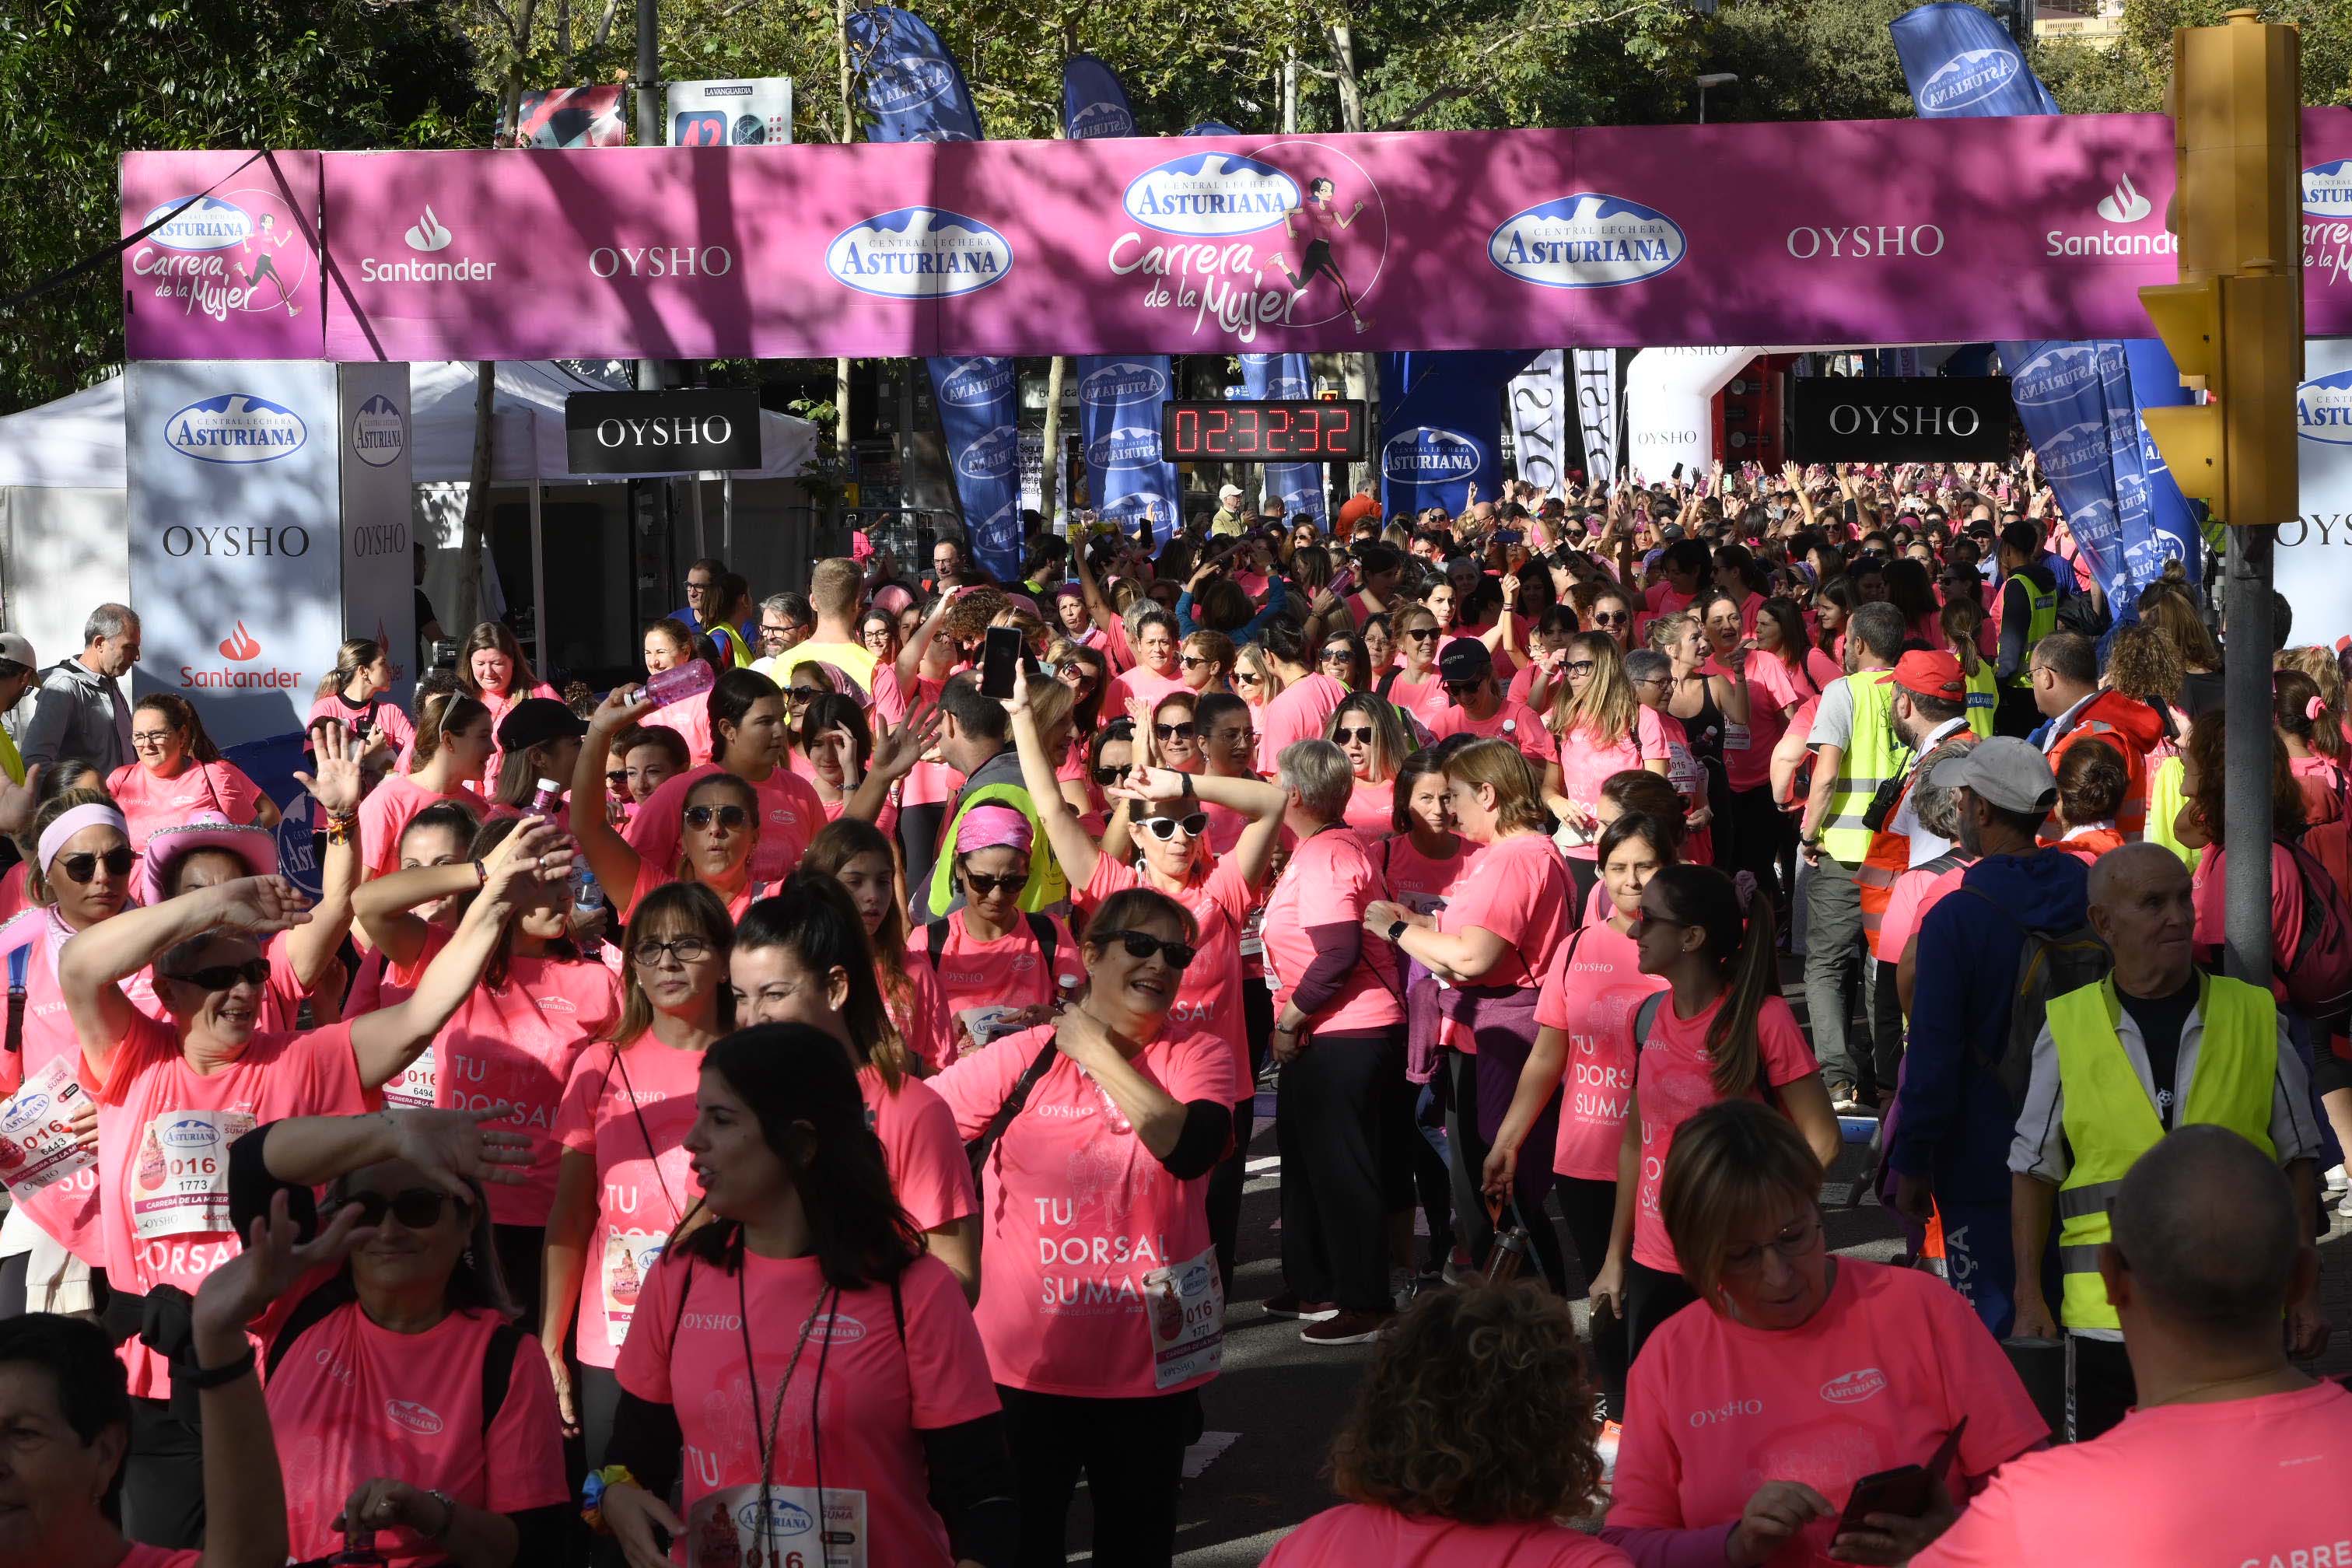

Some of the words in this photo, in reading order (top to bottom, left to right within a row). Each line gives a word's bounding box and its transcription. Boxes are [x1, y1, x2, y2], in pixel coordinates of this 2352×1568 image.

[715, 86, 752, 95] VANGUARDIA
[1164, 181, 1220, 190] CENTRAL
[1226, 179, 1282, 189] LECHERA
[1137, 184, 1286, 216] ASTURIANA
[869, 237, 928, 248] CENTRAL
[1534, 226, 1595, 236] CENTRAL
[1601, 224, 1664, 234] LECHERA
[1787, 224, 1945, 258] OYSHO
[841, 241, 998, 275] ASTURIANA
[1108, 233, 1255, 275] Carrera
[1503, 229, 1671, 265] ASTURIANA
[2319, 245, 2333, 268] la
[133, 247, 225, 276] Carrera
[361, 257, 497, 282] Santander
[589, 247, 732, 279] OYSHO
[156, 278, 173, 298] de
[176, 276, 188, 298] la
[187, 274, 258, 322] Mujer
[1144, 278, 1171, 308] de
[1177, 277, 1196, 308] la
[1192, 271, 1308, 343] Mujer
[176, 419, 297, 446] ASTURIANA
[597, 414, 733, 447] OYSHO
[1176, 410, 1349, 452] 02:32:32
[1829, 404, 1979, 437] OYSHO
[356, 422, 401, 450] ASTURIANA
[1638, 429, 1697, 445] OYSHO
[1384, 448, 1473, 471] ASTURIANA
[163, 525, 310, 558] OYSHO
[354, 523, 406, 558] OYSHO
[180, 666, 302, 689] Santander
[1574, 962, 1614, 973] OYSHO
[454, 1054, 486, 1082] TU
[387, 1094, 413, 1104] CARRERA
[413, 1087, 433, 1097] 6494
[4, 1097, 48, 1132] ASTURIANA
[1039, 1104, 1094, 1118] OYSHO
[23, 1118, 65, 1150] 016
[40, 1136, 67, 1157] 6443
[167, 1132, 216, 1143] ASTURIANA
[170, 1157, 217, 1175] 016
[23, 1168, 59, 1192] OYSHO
[179, 1179, 208, 1191] 1773
[146, 1199, 178, 1209] CARRERA
[178, 1196, 191, 1205] DE
[606, 1185, 637, 1213] TU
[1034, 1197, 1073, 1226] TU
[145, 1214, 179, 1229] OYSHO
[1039, 1233, 1170, 1265] DORSAL
[1041, 1274, 1139, 1306] SUMA
[684, 1313, 742, 1332] OYSHO
[1186, 1300, 1213, 1323] 016
[1690, 1399, 1762, 1428] OYSHO
